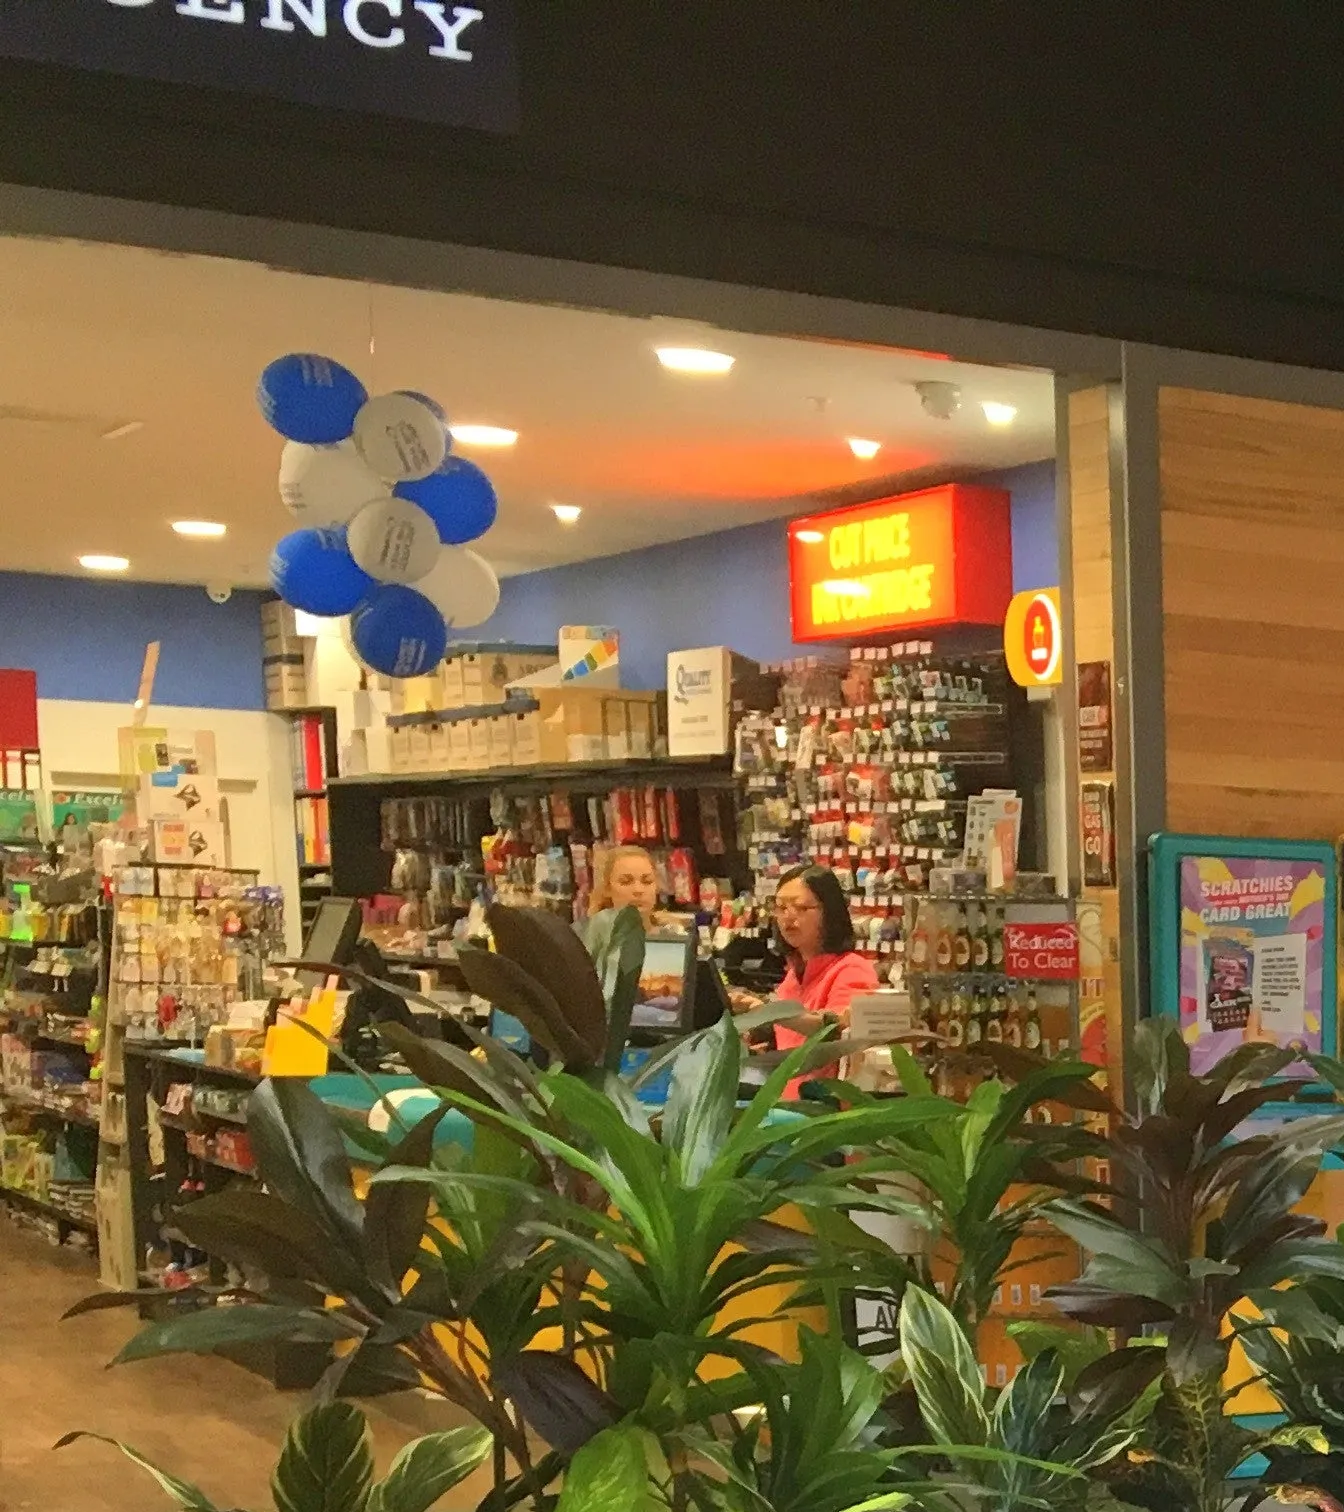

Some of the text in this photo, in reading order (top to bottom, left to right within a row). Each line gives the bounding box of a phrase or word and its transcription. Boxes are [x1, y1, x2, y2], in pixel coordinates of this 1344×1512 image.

[105, 0, 484, 62] NCY
[1200, 875, 1293, 898] SCRATCHIES
[1200, 906, 1240, 923] CARD
[1245, 902, 1291, 920] GREAT
[1008, 931, 1074, 949] Reduced
[1008, 952, 1076, 968] To Clear
